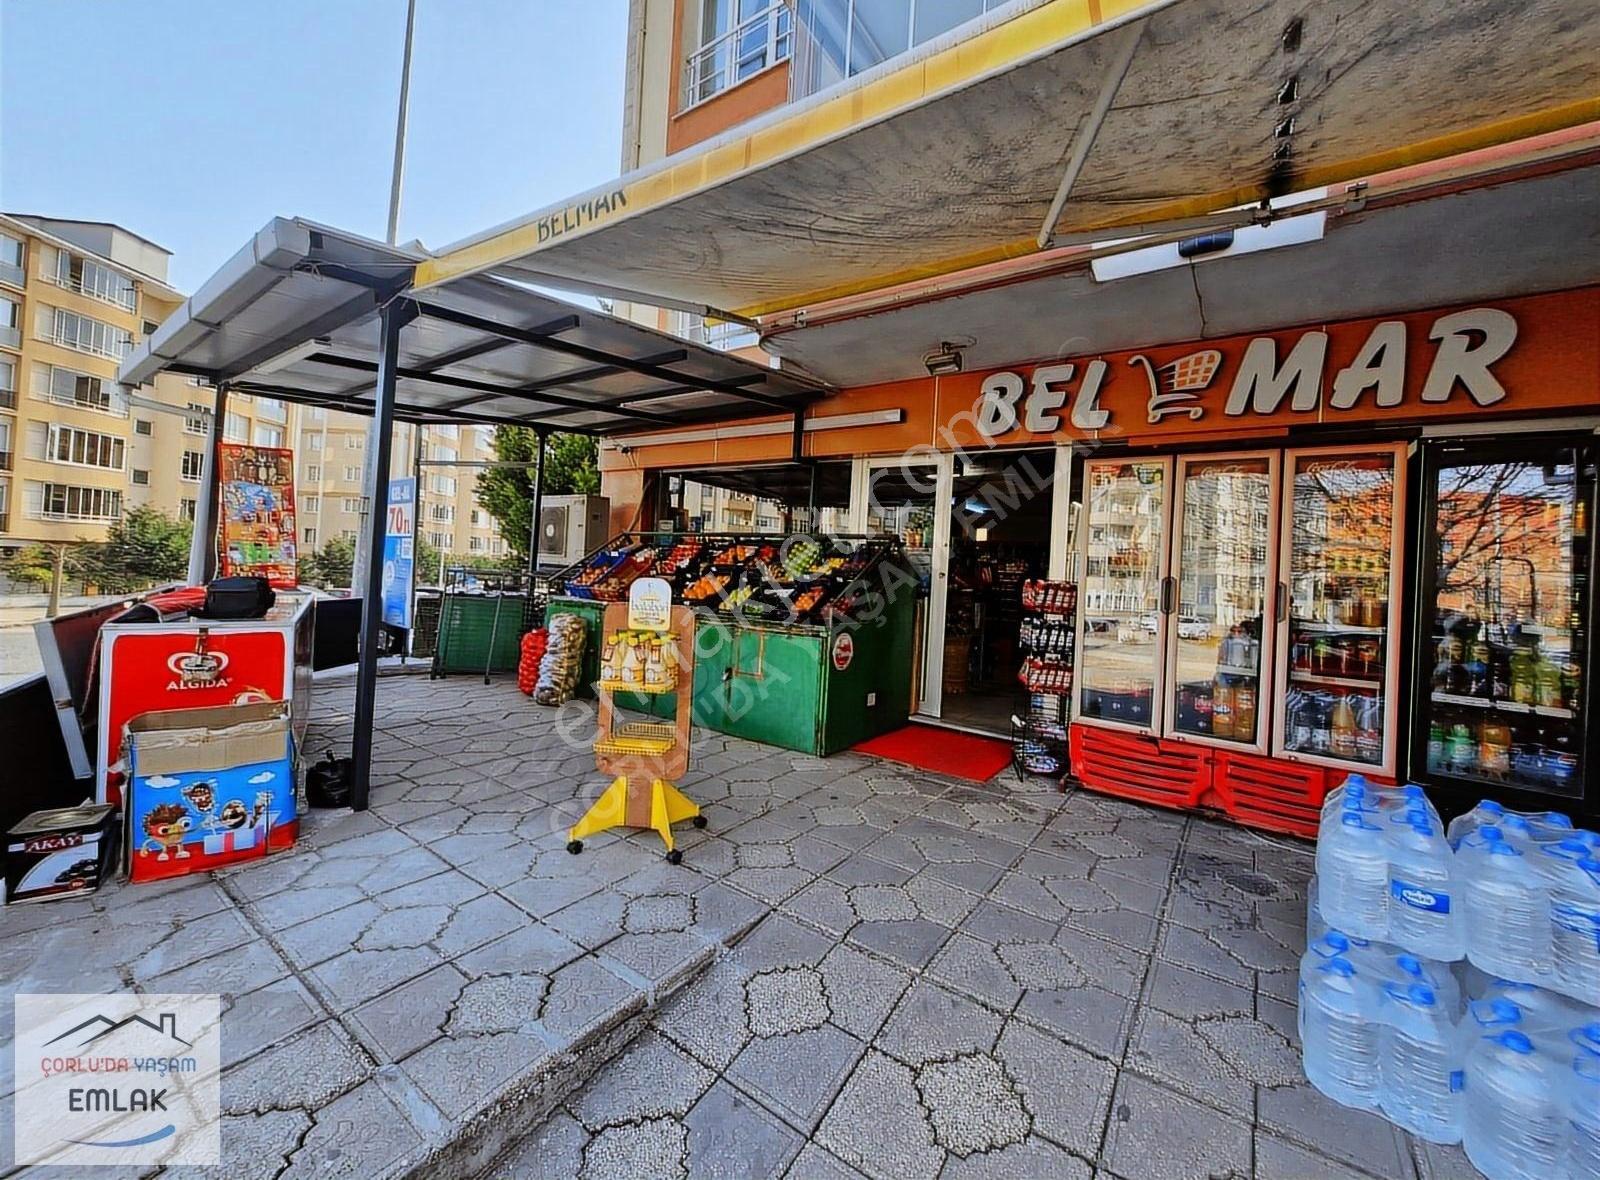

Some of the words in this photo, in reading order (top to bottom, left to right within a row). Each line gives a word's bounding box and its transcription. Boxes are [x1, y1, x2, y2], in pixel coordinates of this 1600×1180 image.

[977, 359, 1110, 437] BEL
[1224, 307, 1519, 416] MAR
[165, 678, 229, 691] ALGIDA
[26, 835, 81, 852] AKAY
